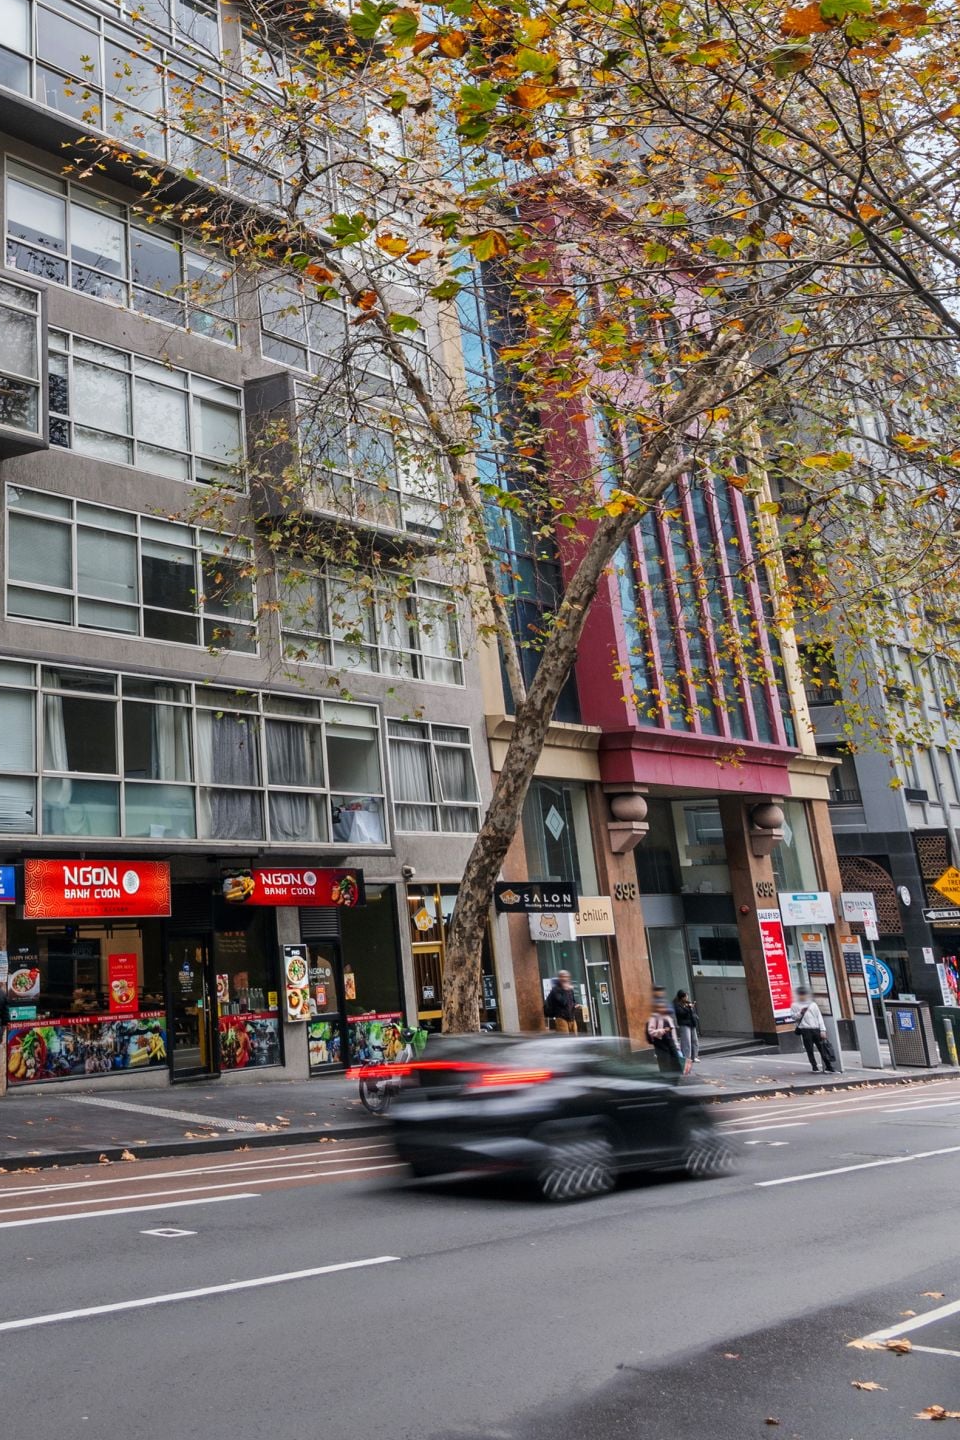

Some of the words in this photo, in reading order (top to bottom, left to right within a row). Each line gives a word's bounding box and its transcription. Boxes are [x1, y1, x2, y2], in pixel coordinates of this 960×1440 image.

[63, 866, 118, 886] NGON
[260, 872, 302, 885] NGON
[64, 888, 90, 898] BANH
[614, 883, 636, 900] 398
[756, 882, 774, 897] 398
[524, 894, 572, 902] SALON
[583, 910, 608, 922] chillin
[538, 930, 562, 938] chillin
